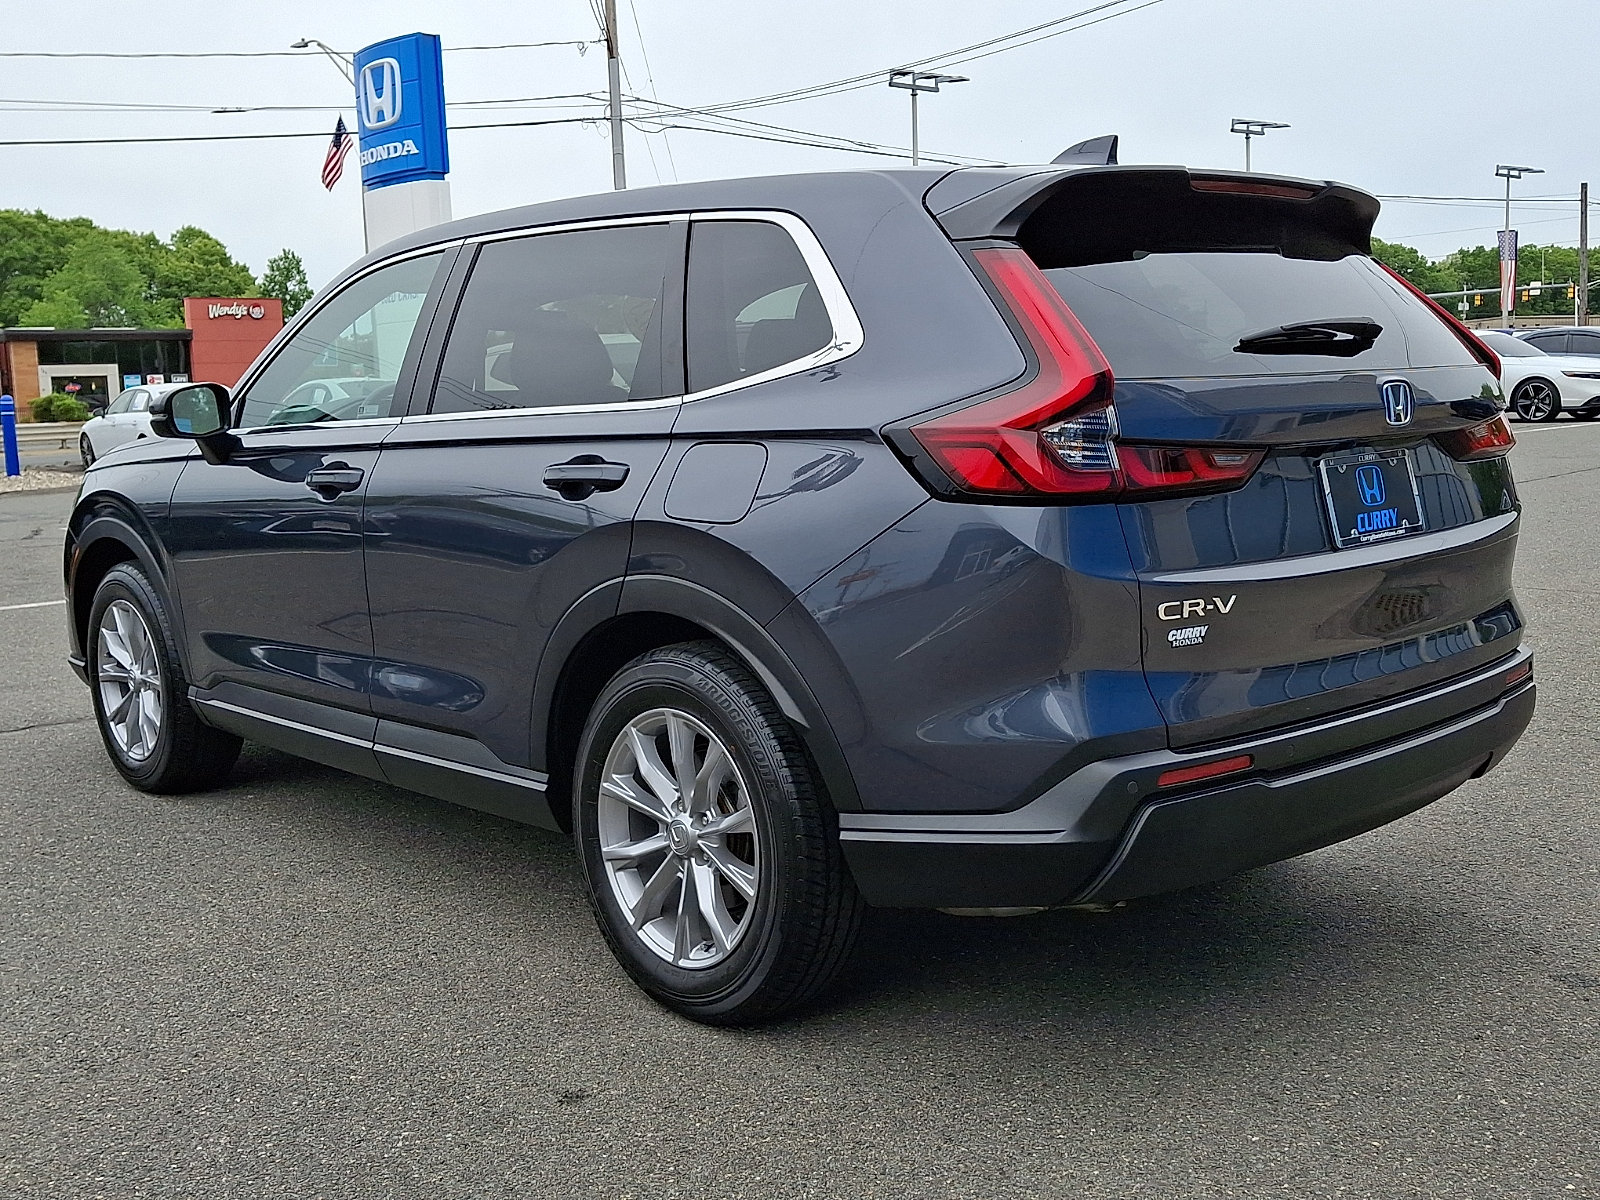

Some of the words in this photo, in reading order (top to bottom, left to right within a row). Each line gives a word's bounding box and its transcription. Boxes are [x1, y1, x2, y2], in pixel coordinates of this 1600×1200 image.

[360, 140, 419, 167] HONDA
[208, 301, 249, 319] Wendy's
[1357, 508, 1398, 533] CURRY
[1157, 594, 1238, 622] CR-V
[1167, 625, 1209, 641] CURRY
[1172, 637, 1204, 648] HONDA
[695, 676, 779, 791] BRIDGESTONE
